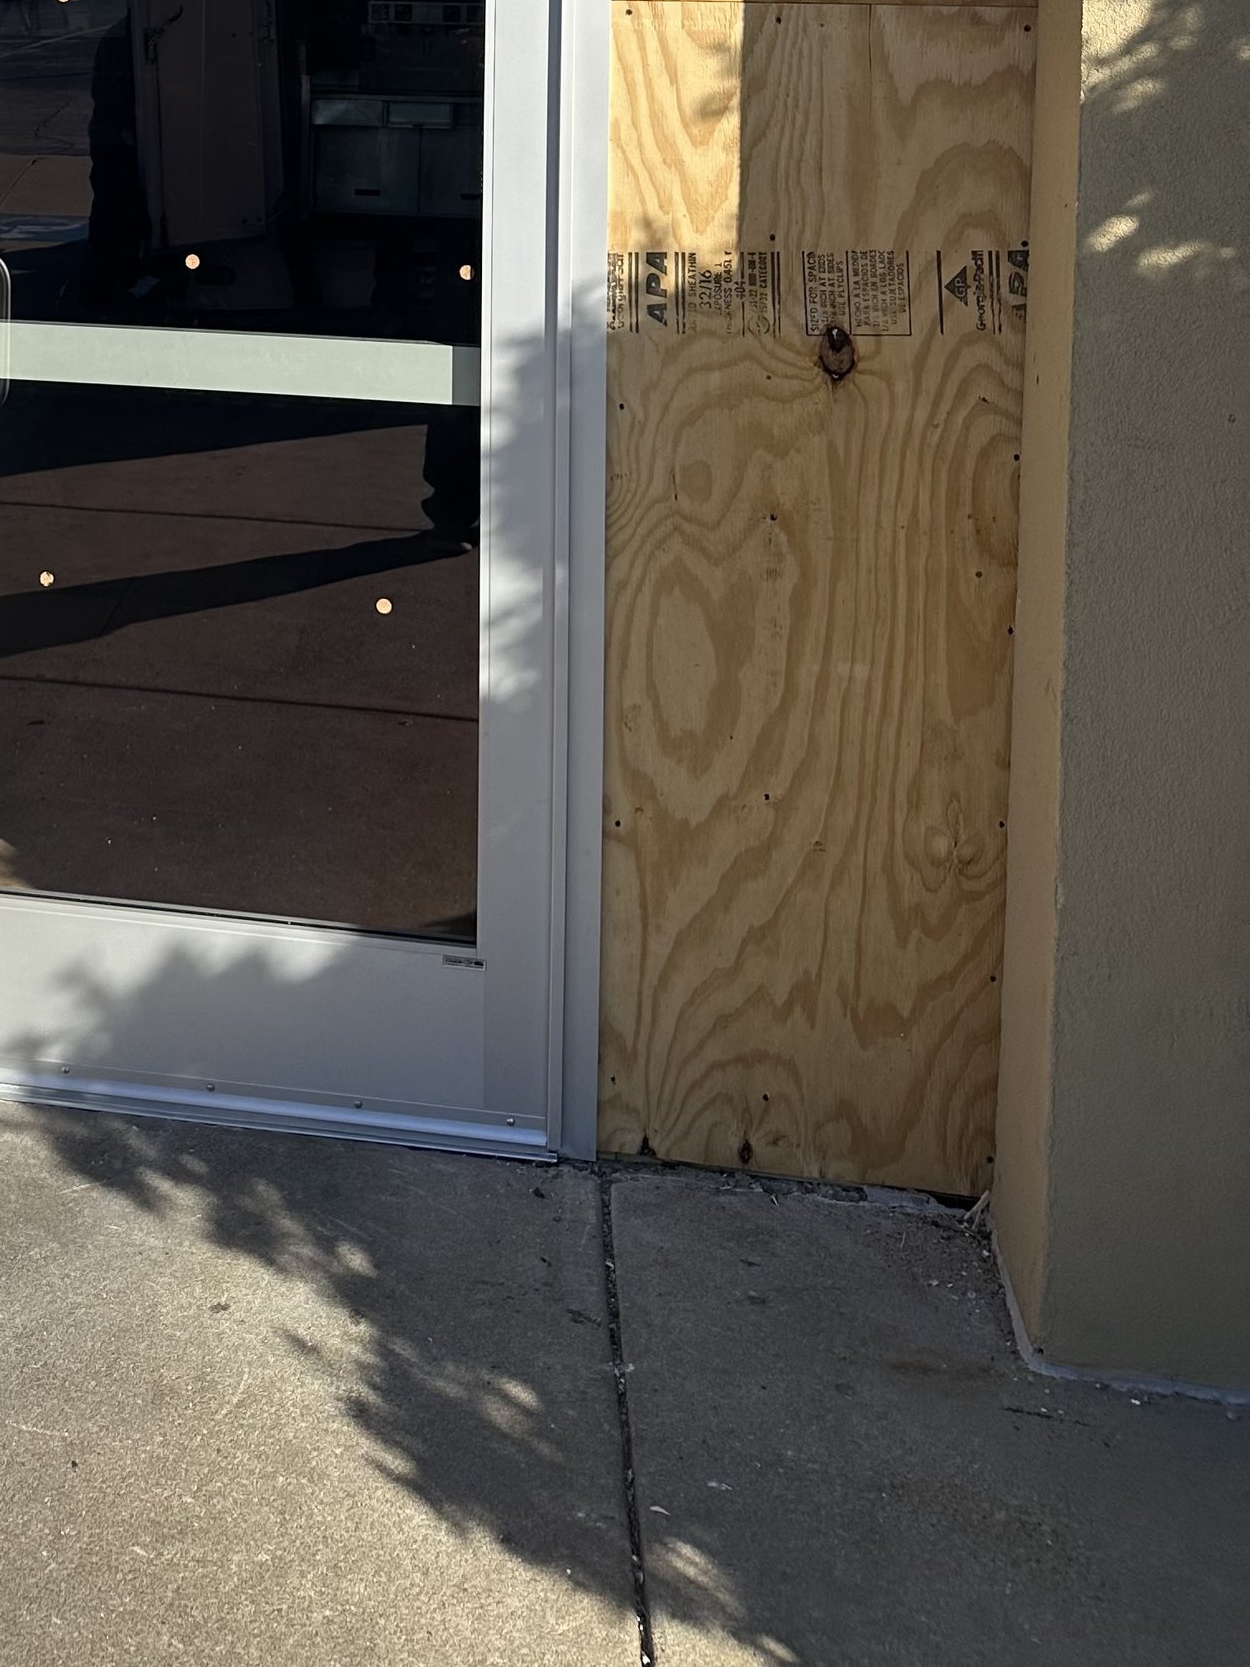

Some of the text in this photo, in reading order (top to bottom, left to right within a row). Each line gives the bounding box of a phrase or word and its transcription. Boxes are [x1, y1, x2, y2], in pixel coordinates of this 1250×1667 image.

[646, 251, 668, 327] APA
[698, 269, 712, 309] 32/16
[713, 272, 722, 316] XPOSURE
